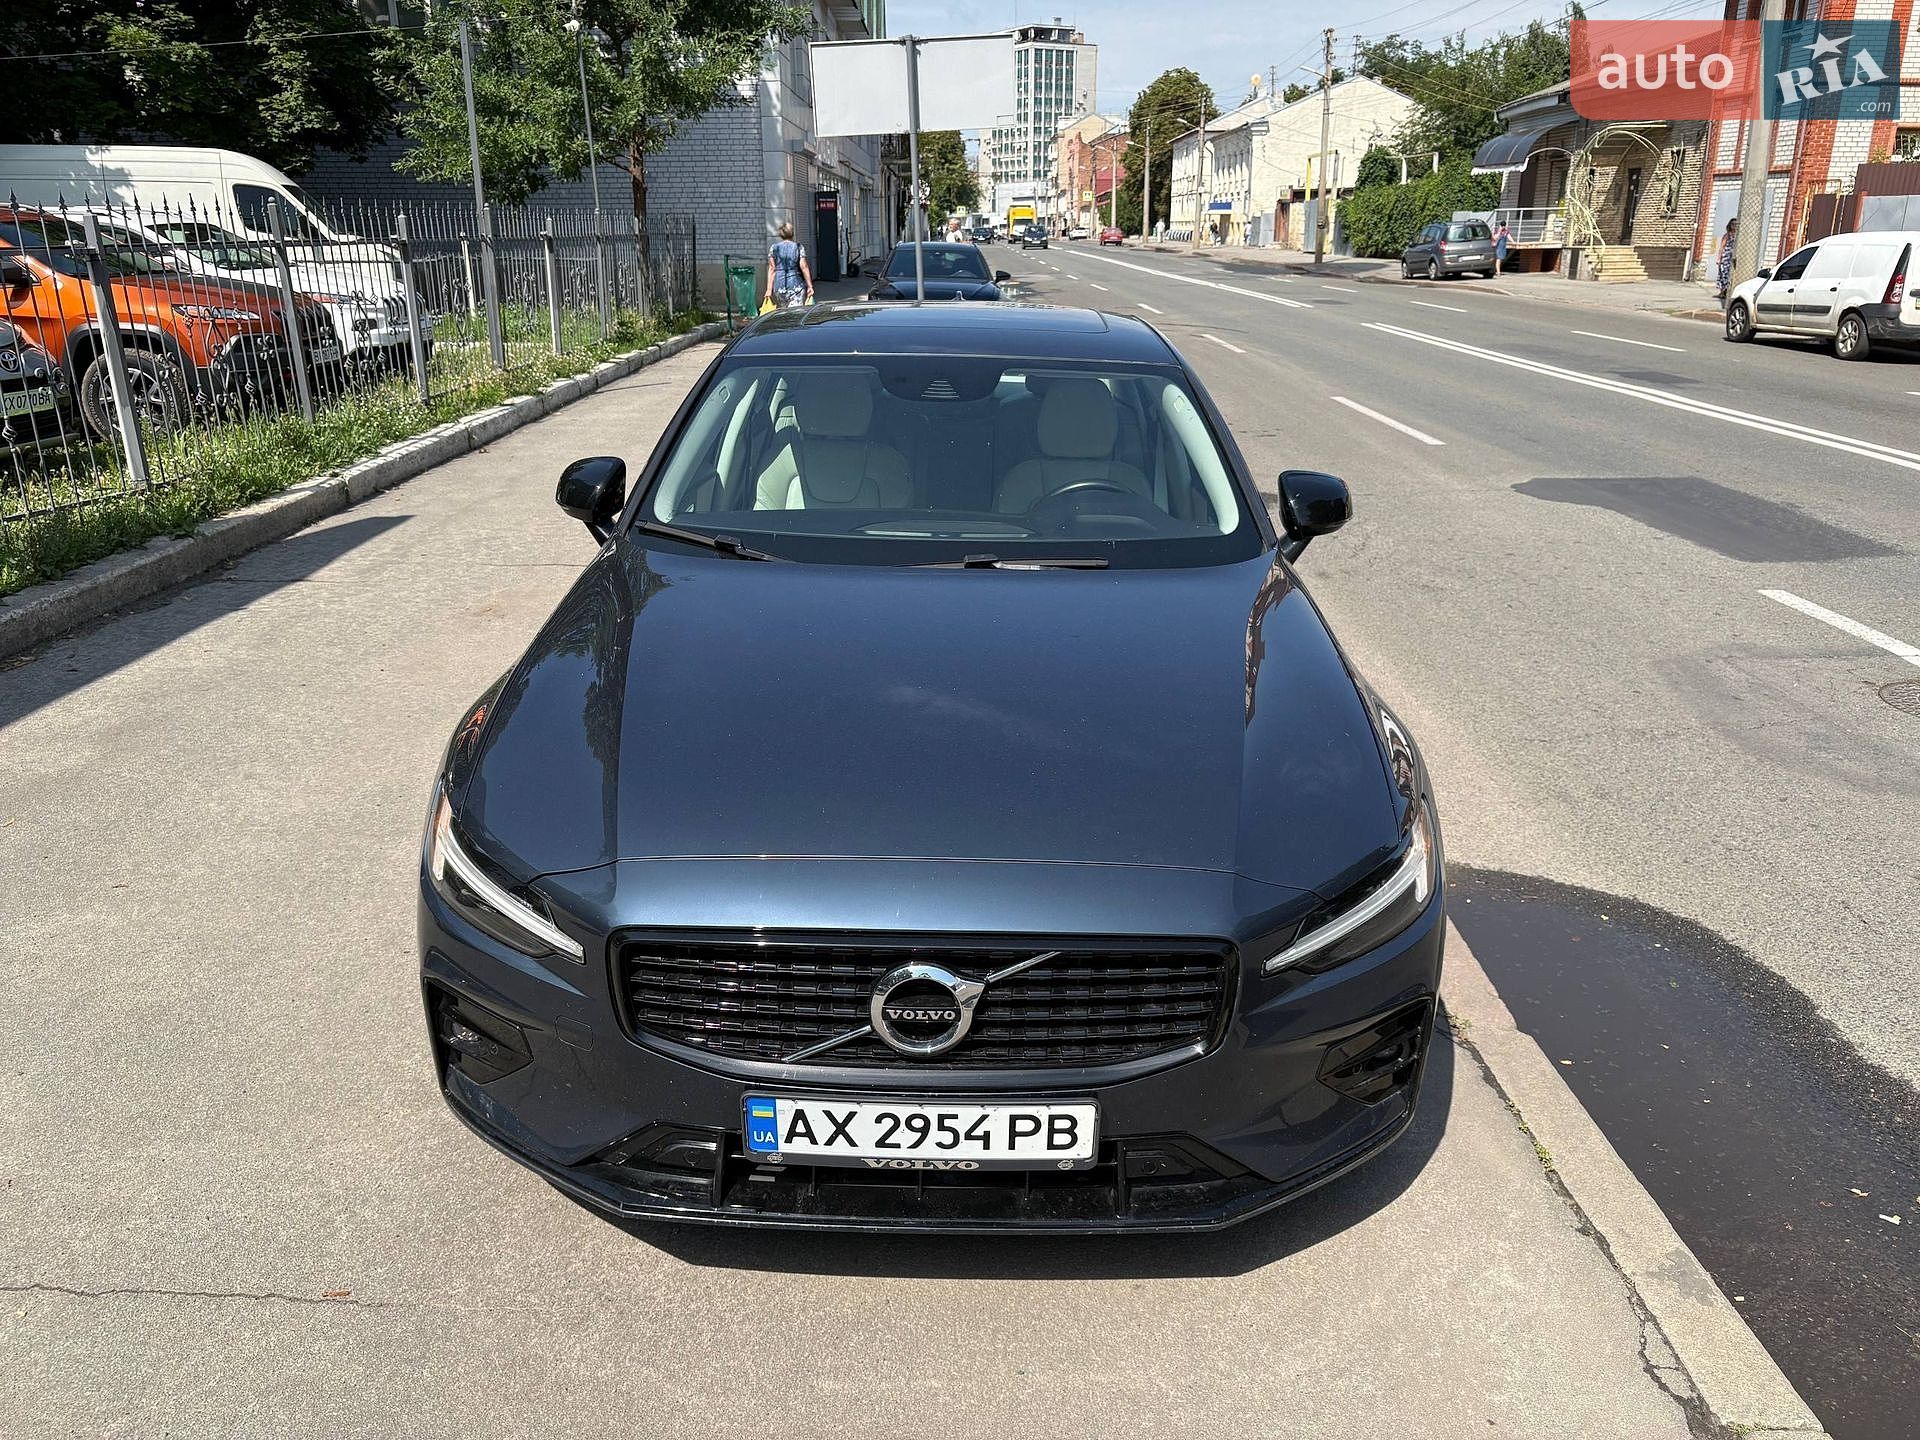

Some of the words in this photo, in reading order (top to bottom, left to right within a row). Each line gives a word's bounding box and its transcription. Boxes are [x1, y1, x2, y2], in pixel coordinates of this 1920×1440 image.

[885, 1009, 956, 1020] VOLVO
[784, 1108, 860, 1148] AX
[873, 1112, 992, 1151] 2954
[1008, 1113, 1079, 1151] PB
[753, 1130, 776, 1144] UA
[860, 1157, 980, 1171] VOLVO
